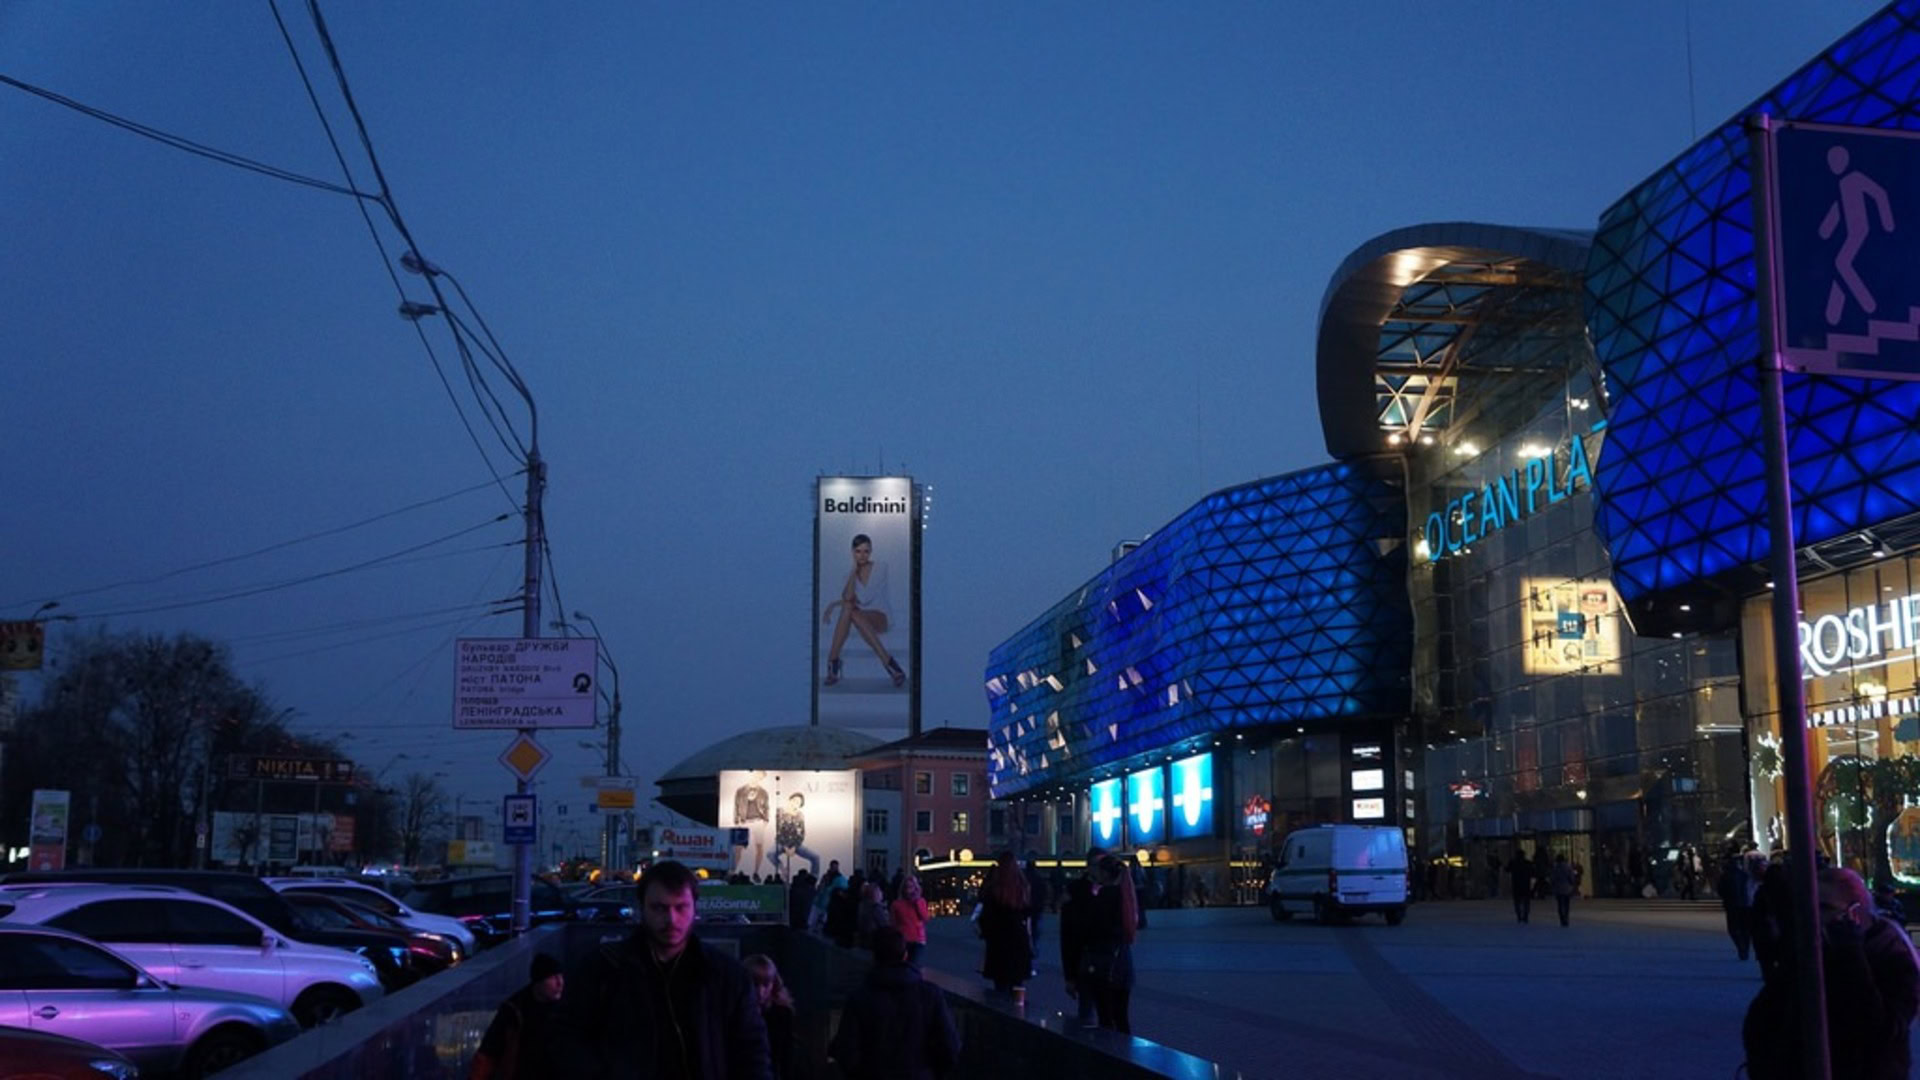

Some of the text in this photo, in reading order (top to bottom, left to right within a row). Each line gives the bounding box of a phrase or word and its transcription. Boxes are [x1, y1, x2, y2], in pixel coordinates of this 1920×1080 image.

[1426, 418, 1608, 561] OCEAN PLA
[824, 496, 906, 512] Baldinini
[515, 642, 569, 652] ДРУЖБИ
[490, 673, 541, 683] ПАТОНА
[461, 706, 563, 717] ЛЕНІНГРАДСЬКА
[257, 759, 315, 774] NIKITA
